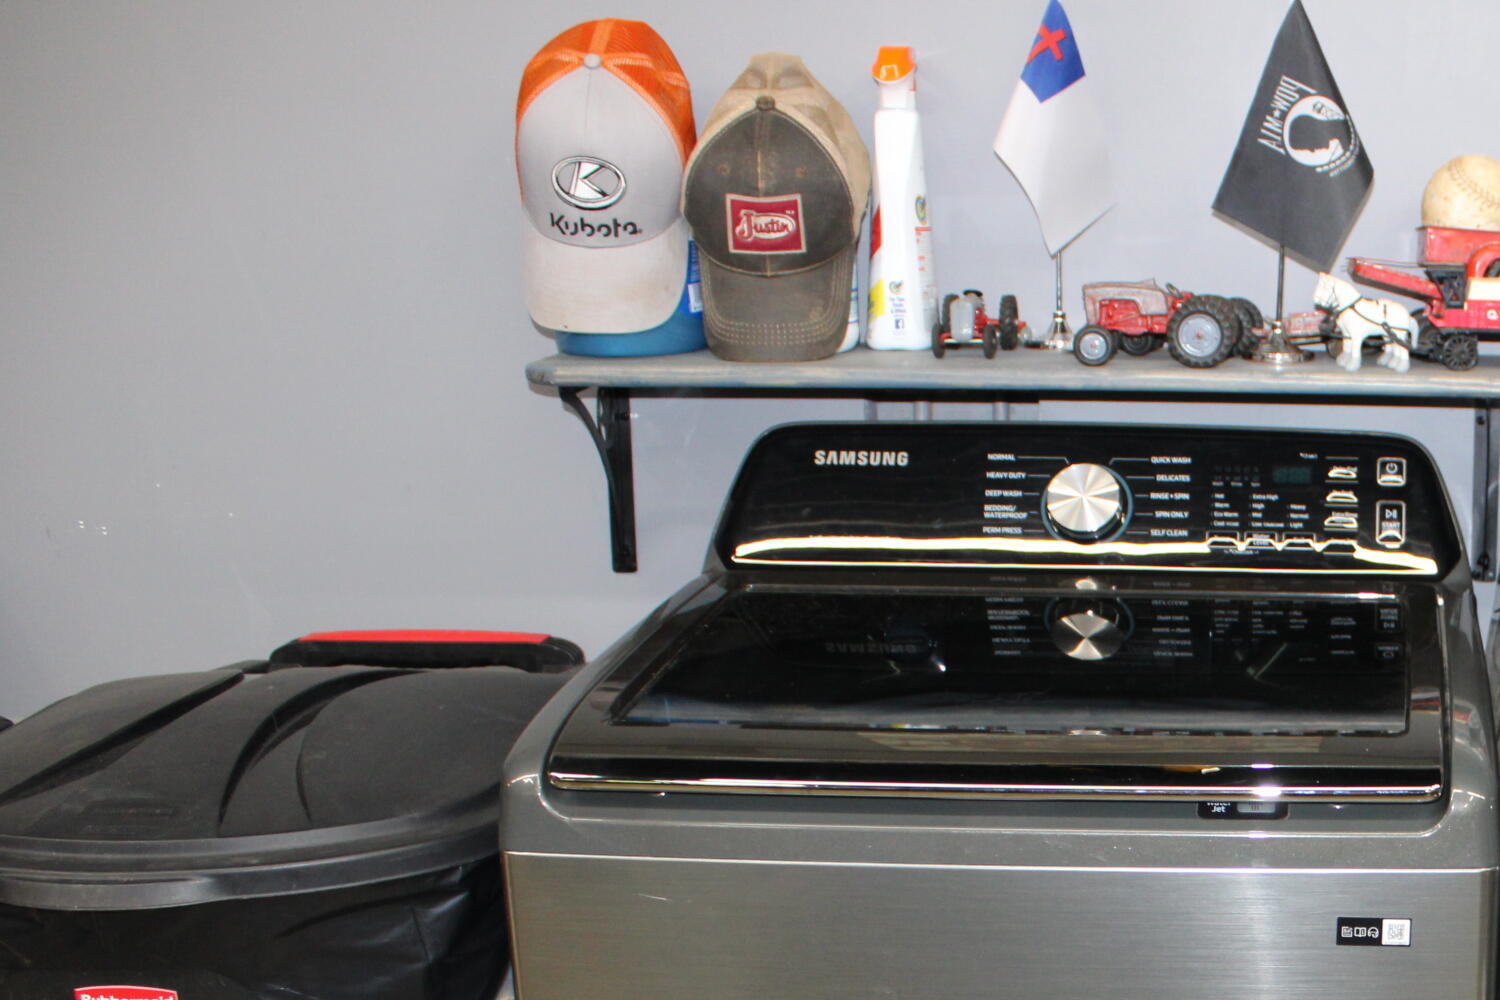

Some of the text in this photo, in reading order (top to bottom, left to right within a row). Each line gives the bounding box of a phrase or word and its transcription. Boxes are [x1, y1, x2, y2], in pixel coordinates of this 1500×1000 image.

[550, 212, 638, 238] Kubota
[814, 450, 909, 467] SAMSUNG
[986, 471, 1008, 479] HEAVY
[985, 489, 1002, 497] DEEP
